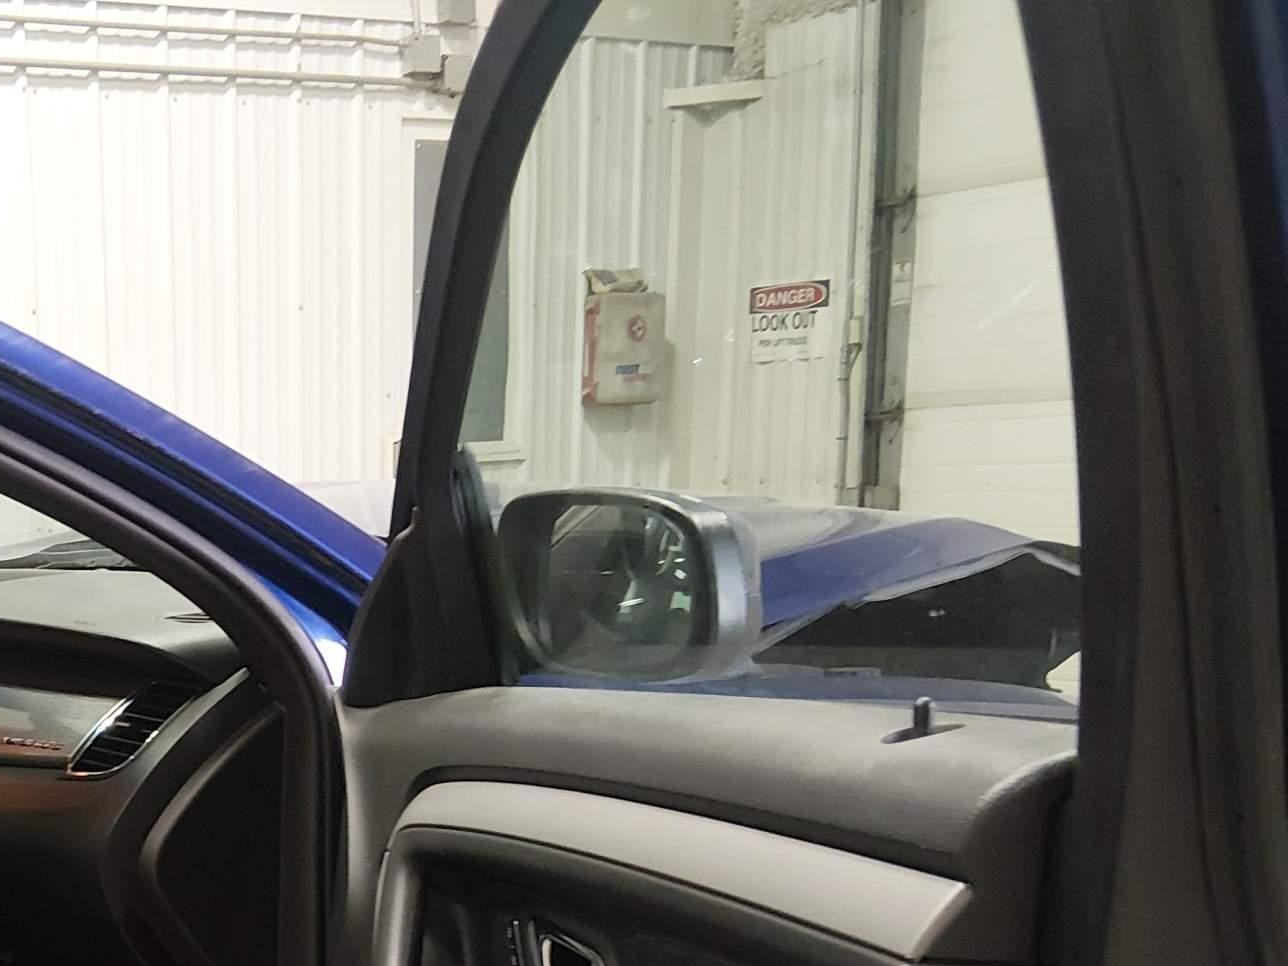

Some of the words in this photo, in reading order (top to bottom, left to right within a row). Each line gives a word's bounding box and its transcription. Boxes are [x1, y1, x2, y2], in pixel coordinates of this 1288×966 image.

[755, 287, 815, 307] DANGER
[752, 312, 790, 333] LOOK
[792, 310, 818, 330] OUT
